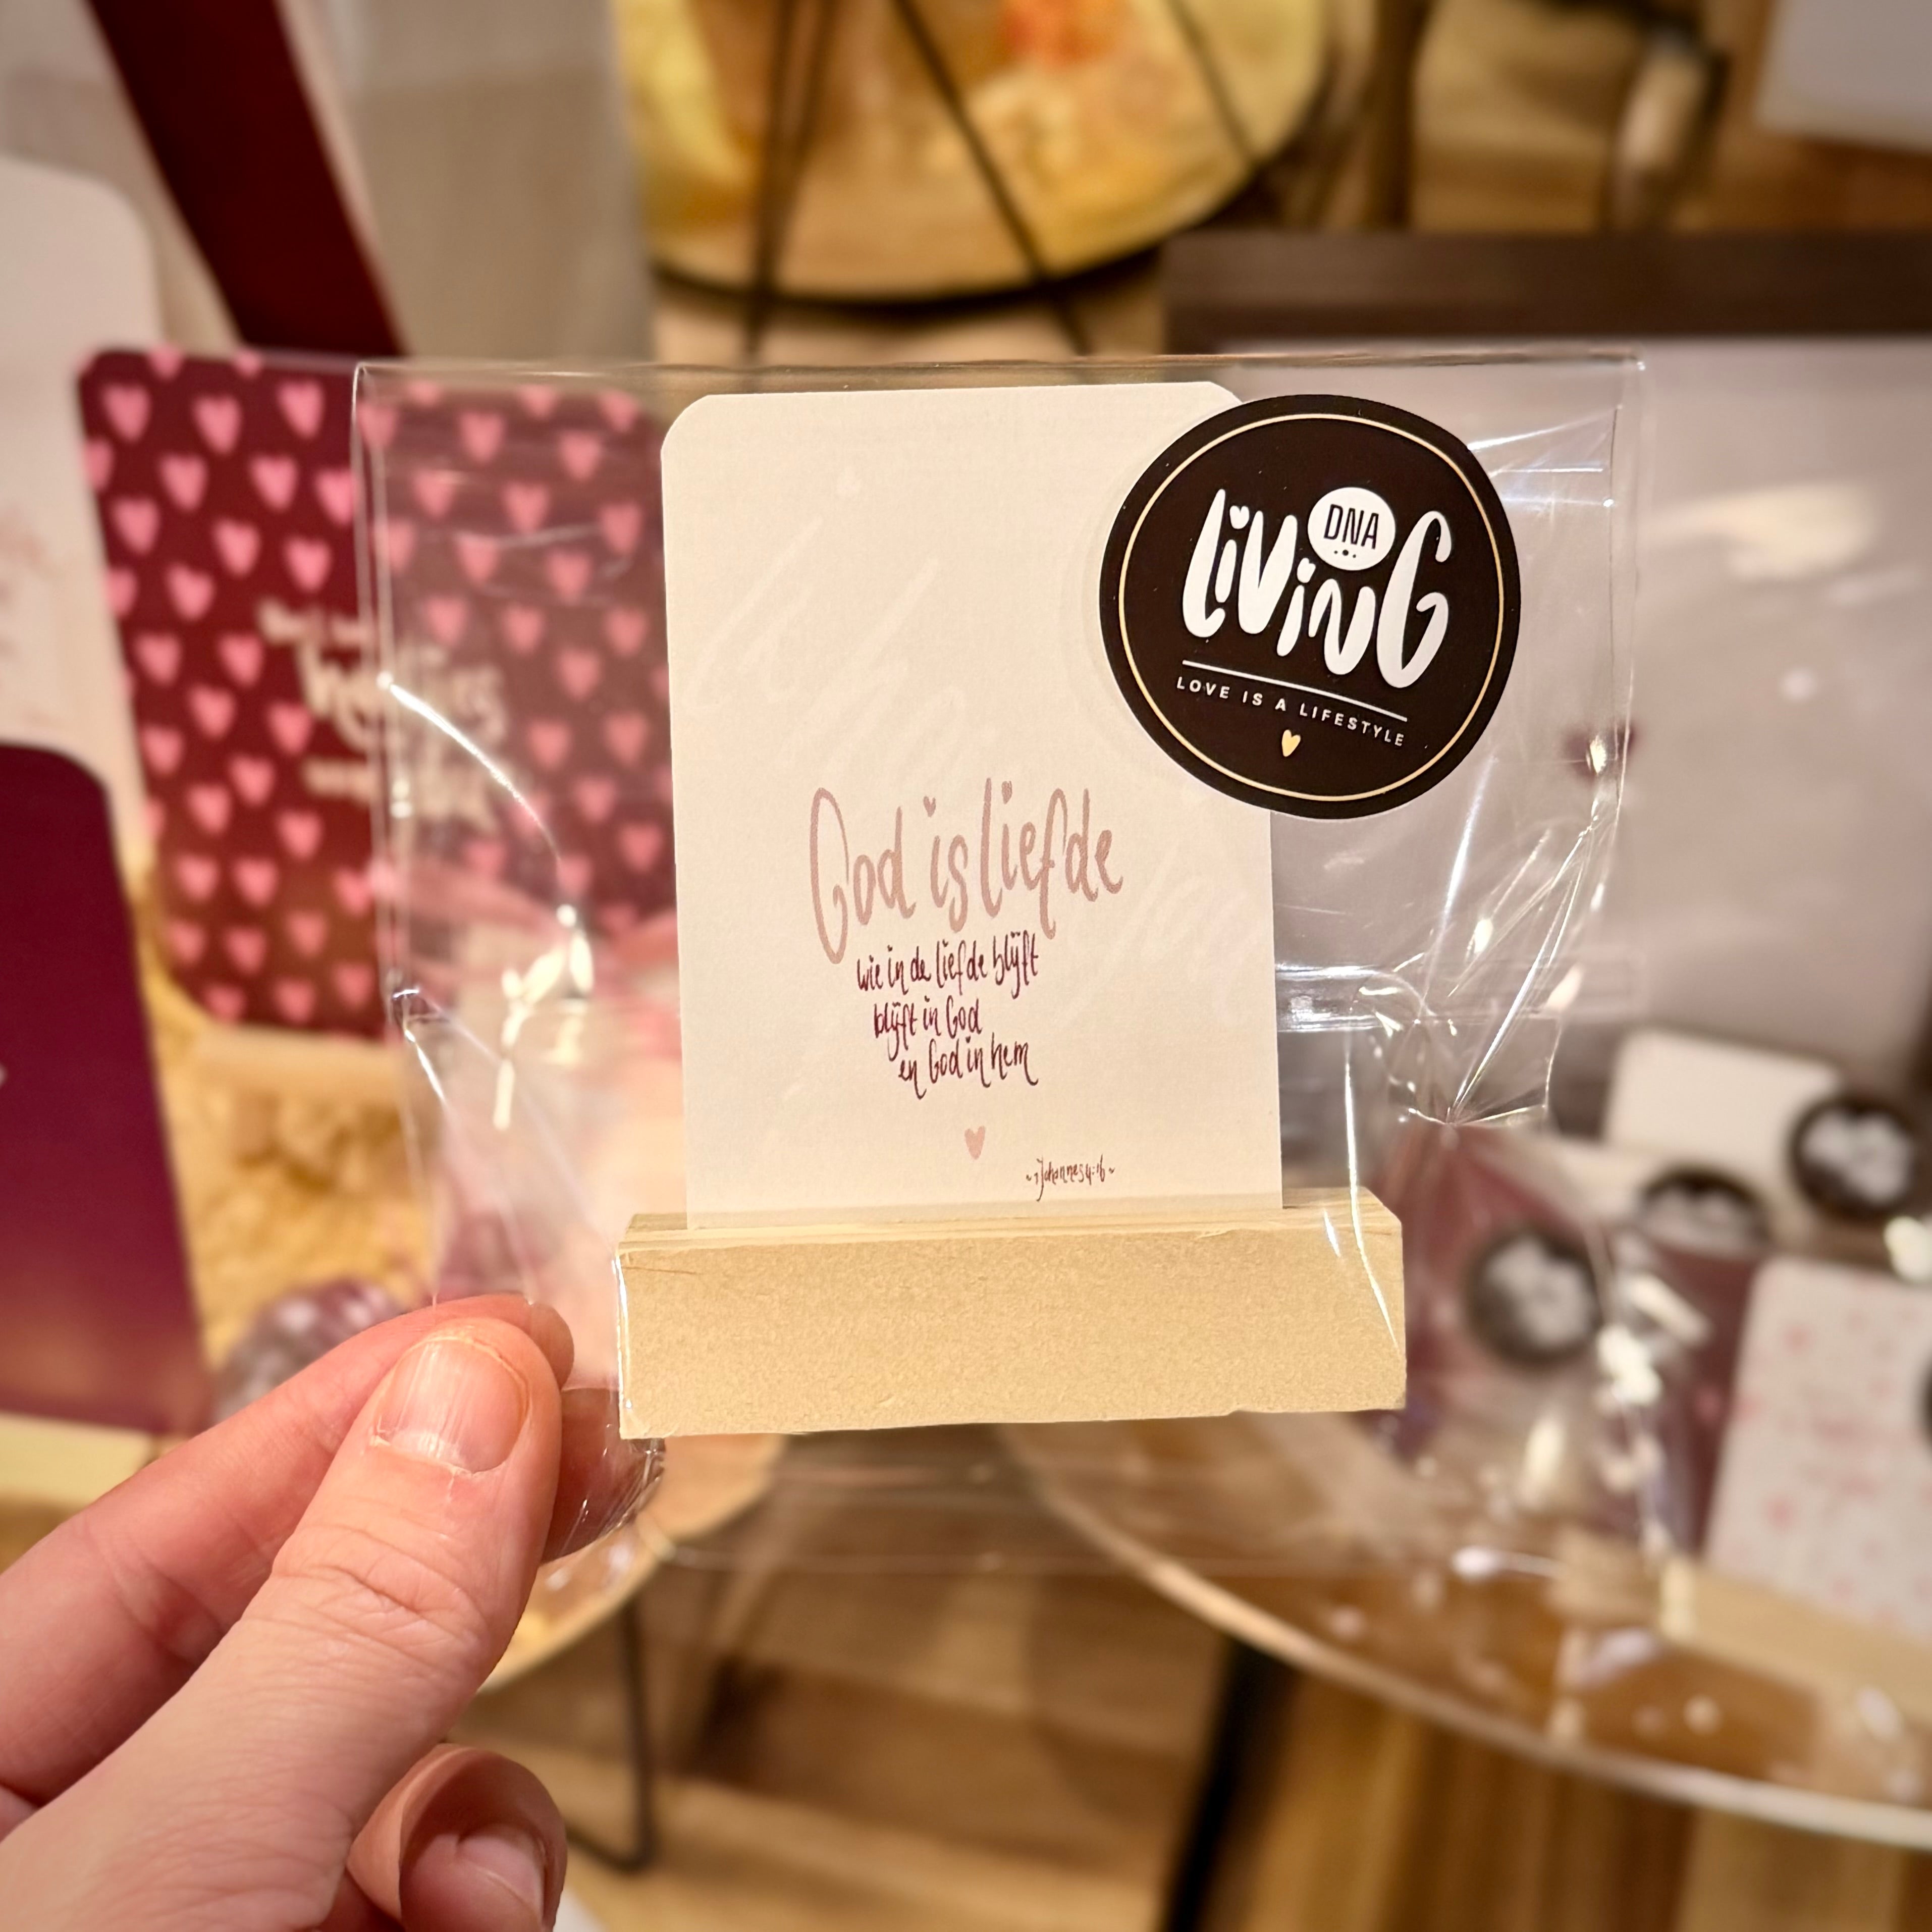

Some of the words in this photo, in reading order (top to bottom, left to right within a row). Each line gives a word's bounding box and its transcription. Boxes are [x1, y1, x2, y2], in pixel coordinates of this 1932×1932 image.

[1323, 504, 1380, 550] DNA
[1176, 676, 1230, 699] LOVE
[1243, 690, 1263, 706] IS
[1275, 697, 1286, 712] A
[1300, 703, 1405, 747] LIFESTYLE
[810, 787, 917, 964] God
[923, 795, 969, 932] is
[980, 778, 1124, 940] liefde
[857, 954, 883, 992] wie
[887, 944, 908, 995] in
[910, 946, 931, 982] de
[936, 939, 988, 996] liefde
[923, 995, 942, 1036] in
[946, 995, 983, 1039] God
[898, 1059, 927, 1100] en
[929, 1038, 963, 1084] God
[965, 1036, 992, 1088] in
[991, 1032, 1039, 1086] hem
